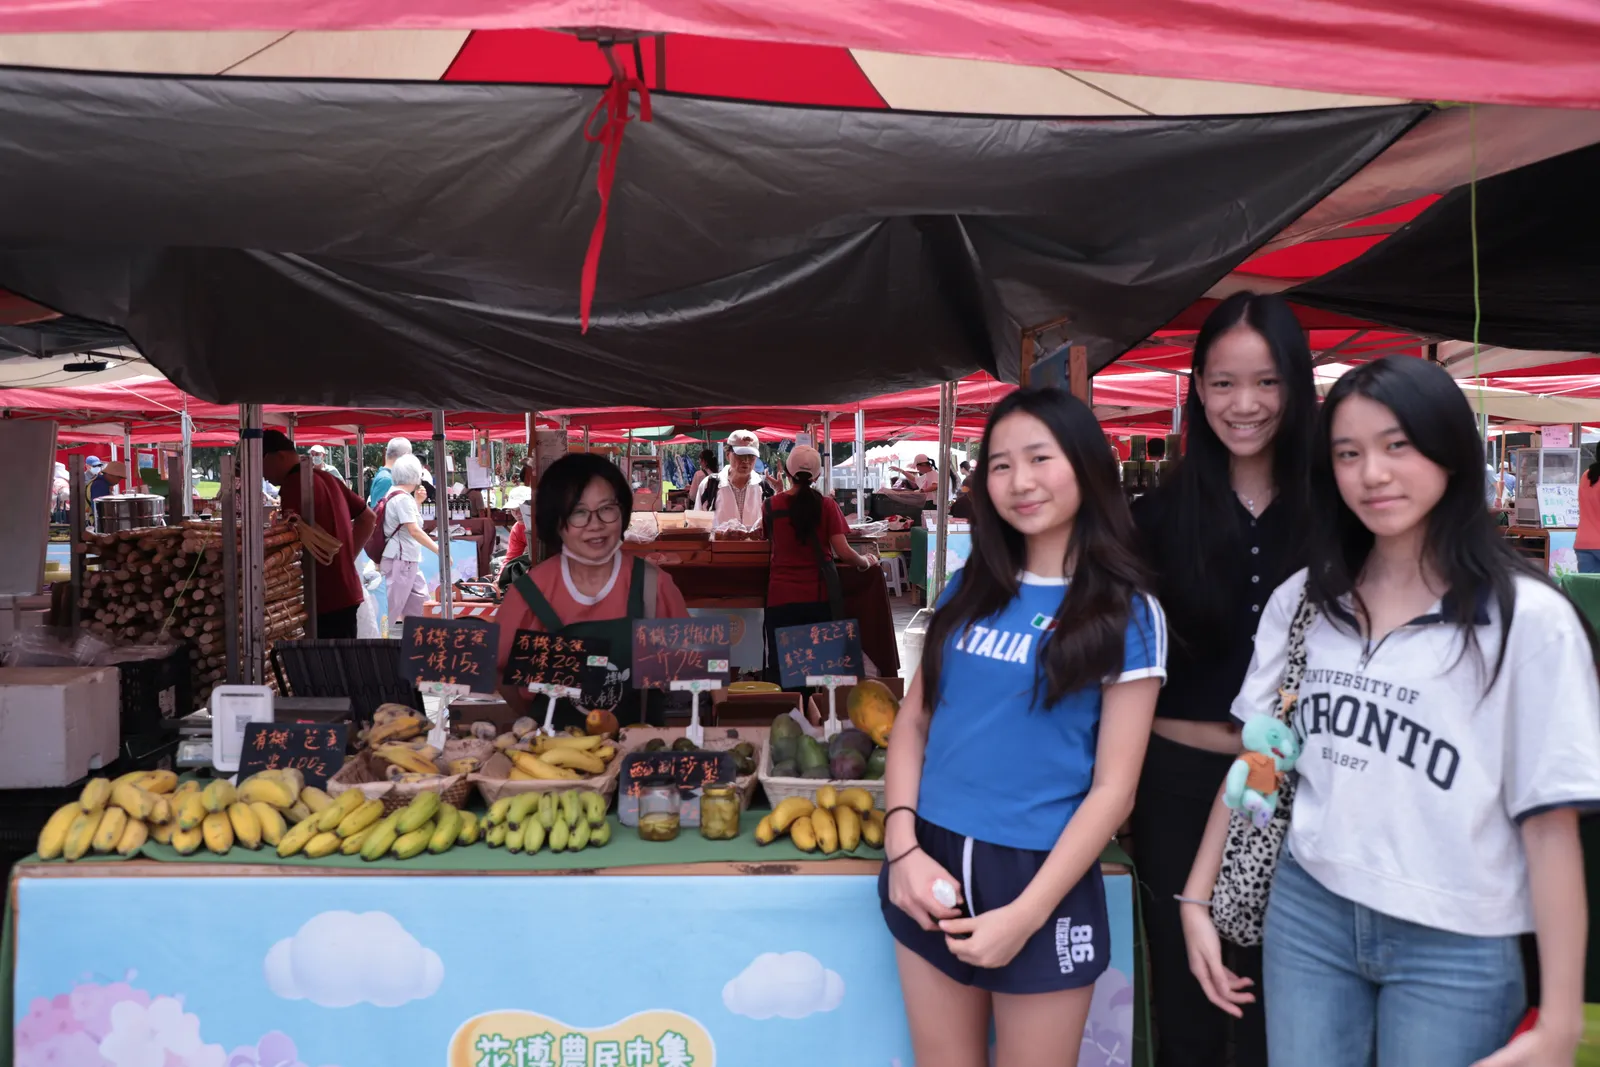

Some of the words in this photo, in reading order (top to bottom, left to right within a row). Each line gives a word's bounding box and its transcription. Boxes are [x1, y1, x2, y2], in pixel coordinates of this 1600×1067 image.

[1396, 686, 1420, 706] OF
[1294, 692, 1460, 791] RONTO
[1055, 917, 1074, 974] CALIFORNIA
[1070, 924, 1095, 963] 98
[475, 1029, 694, 1067] 花博農民市集
